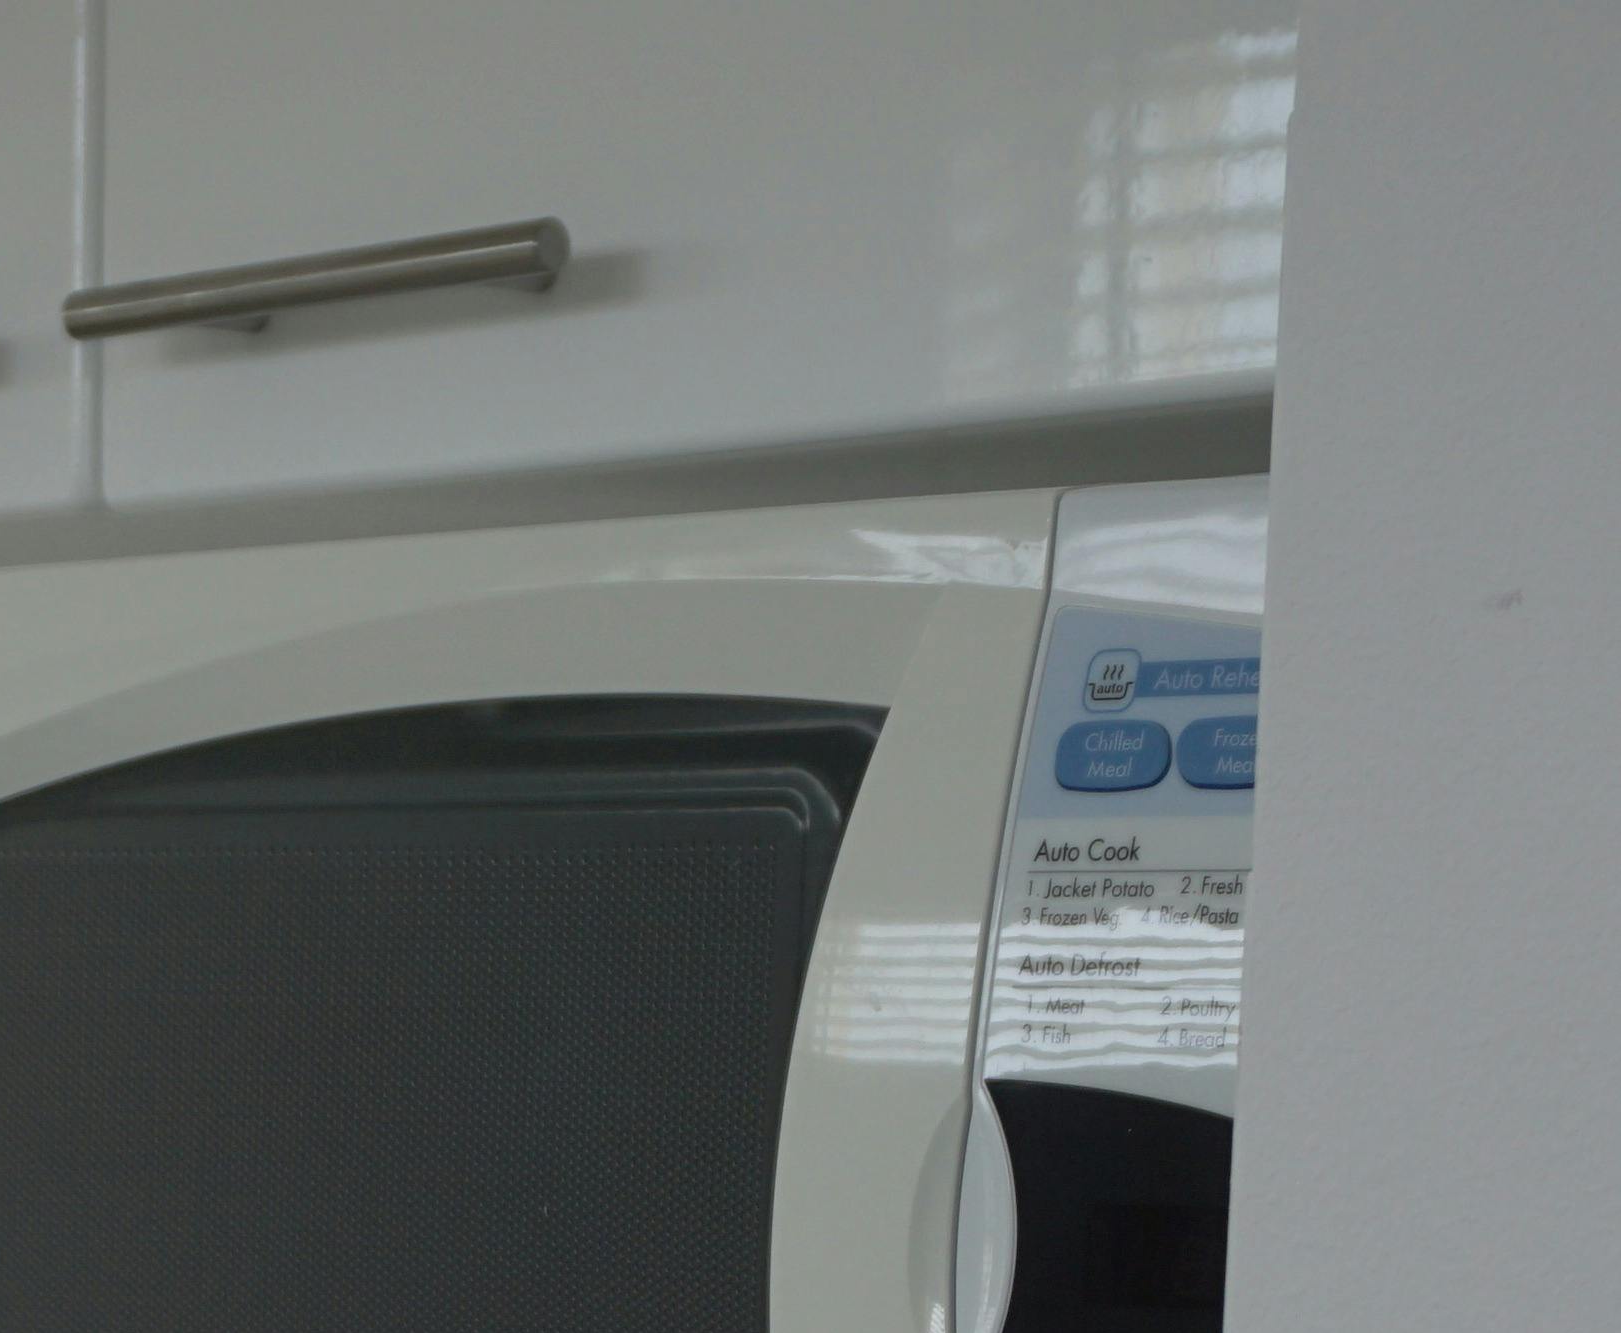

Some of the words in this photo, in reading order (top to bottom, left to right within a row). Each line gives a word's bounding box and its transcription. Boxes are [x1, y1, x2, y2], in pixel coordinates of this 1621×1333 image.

[1153, 669, 1204, 689] Auto
[1211, 663, 1260, 687] Rehe
[1097, 683, 1123, 694] auto
[1085, 729, 1145, 752] Chilled
[1214, 728, 1257, 747] Froze
[1087, 756, 1132, 777] Meal
[1215, 757, 1255, 774] Mea
[1034, 838, 1079, 862] Auto
[1088, 836, 1140, 862] Cook
[1043, 877, 1096, 899] Jacket
[1102, 878, 1155, 897] Potato
[1180, 876, 1196, 894] 2.
[1201, 873, 1243, 896] Fresh
[1040, 907, 1087, 926] Frozen
[1159, 903, 1239, 926] Rice/Pasta
[1019, 953, 1064, 976] Auto
[1070, 951, 1141, 976] Defrost
[1045, 997, 1085, 1014] Meat
[1180, 995, 1236, 1022] Poultry
[1042, 1023, 1071, 1044] Fish
[1179, 1026, 1227, 1048] Bread
